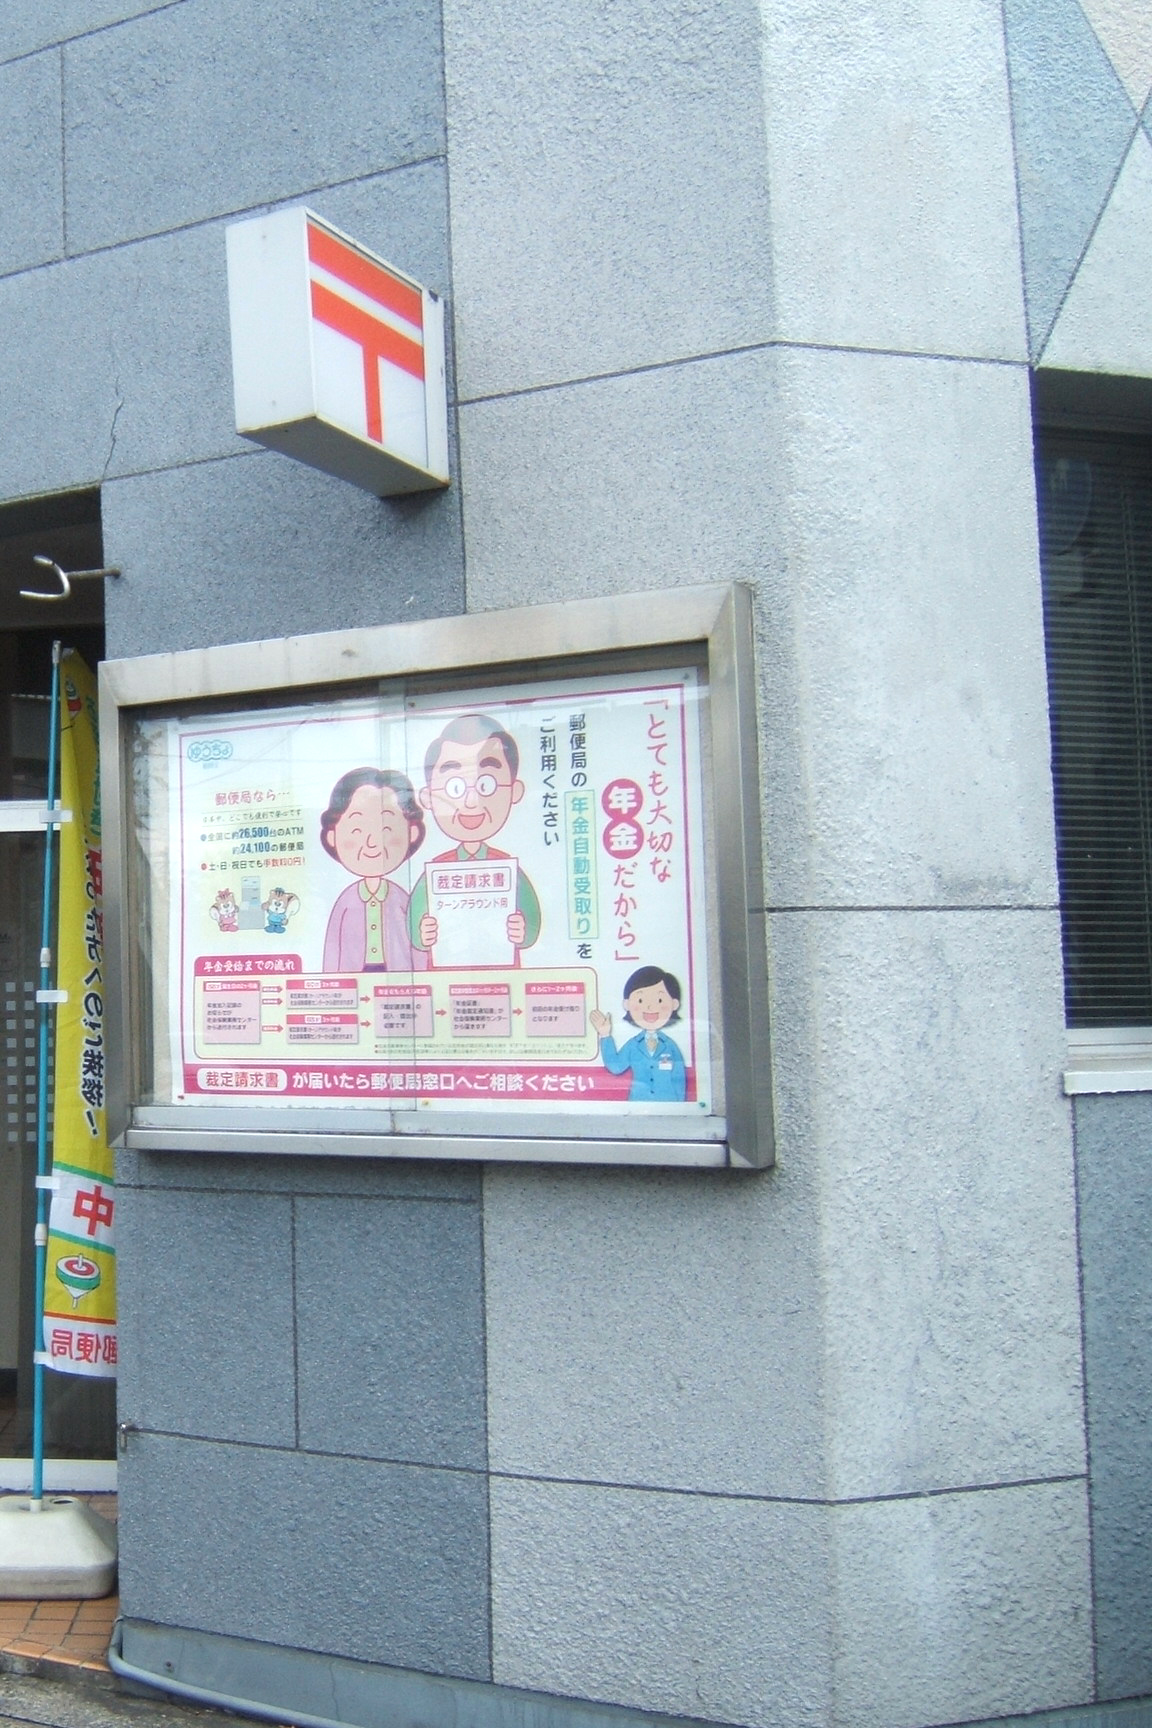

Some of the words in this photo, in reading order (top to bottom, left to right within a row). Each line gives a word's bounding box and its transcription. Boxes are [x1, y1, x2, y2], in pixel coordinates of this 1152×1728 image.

[540, 716, 560, 847] ご利用ください
[205, 1070, 280, 1089] 裁定請求書
